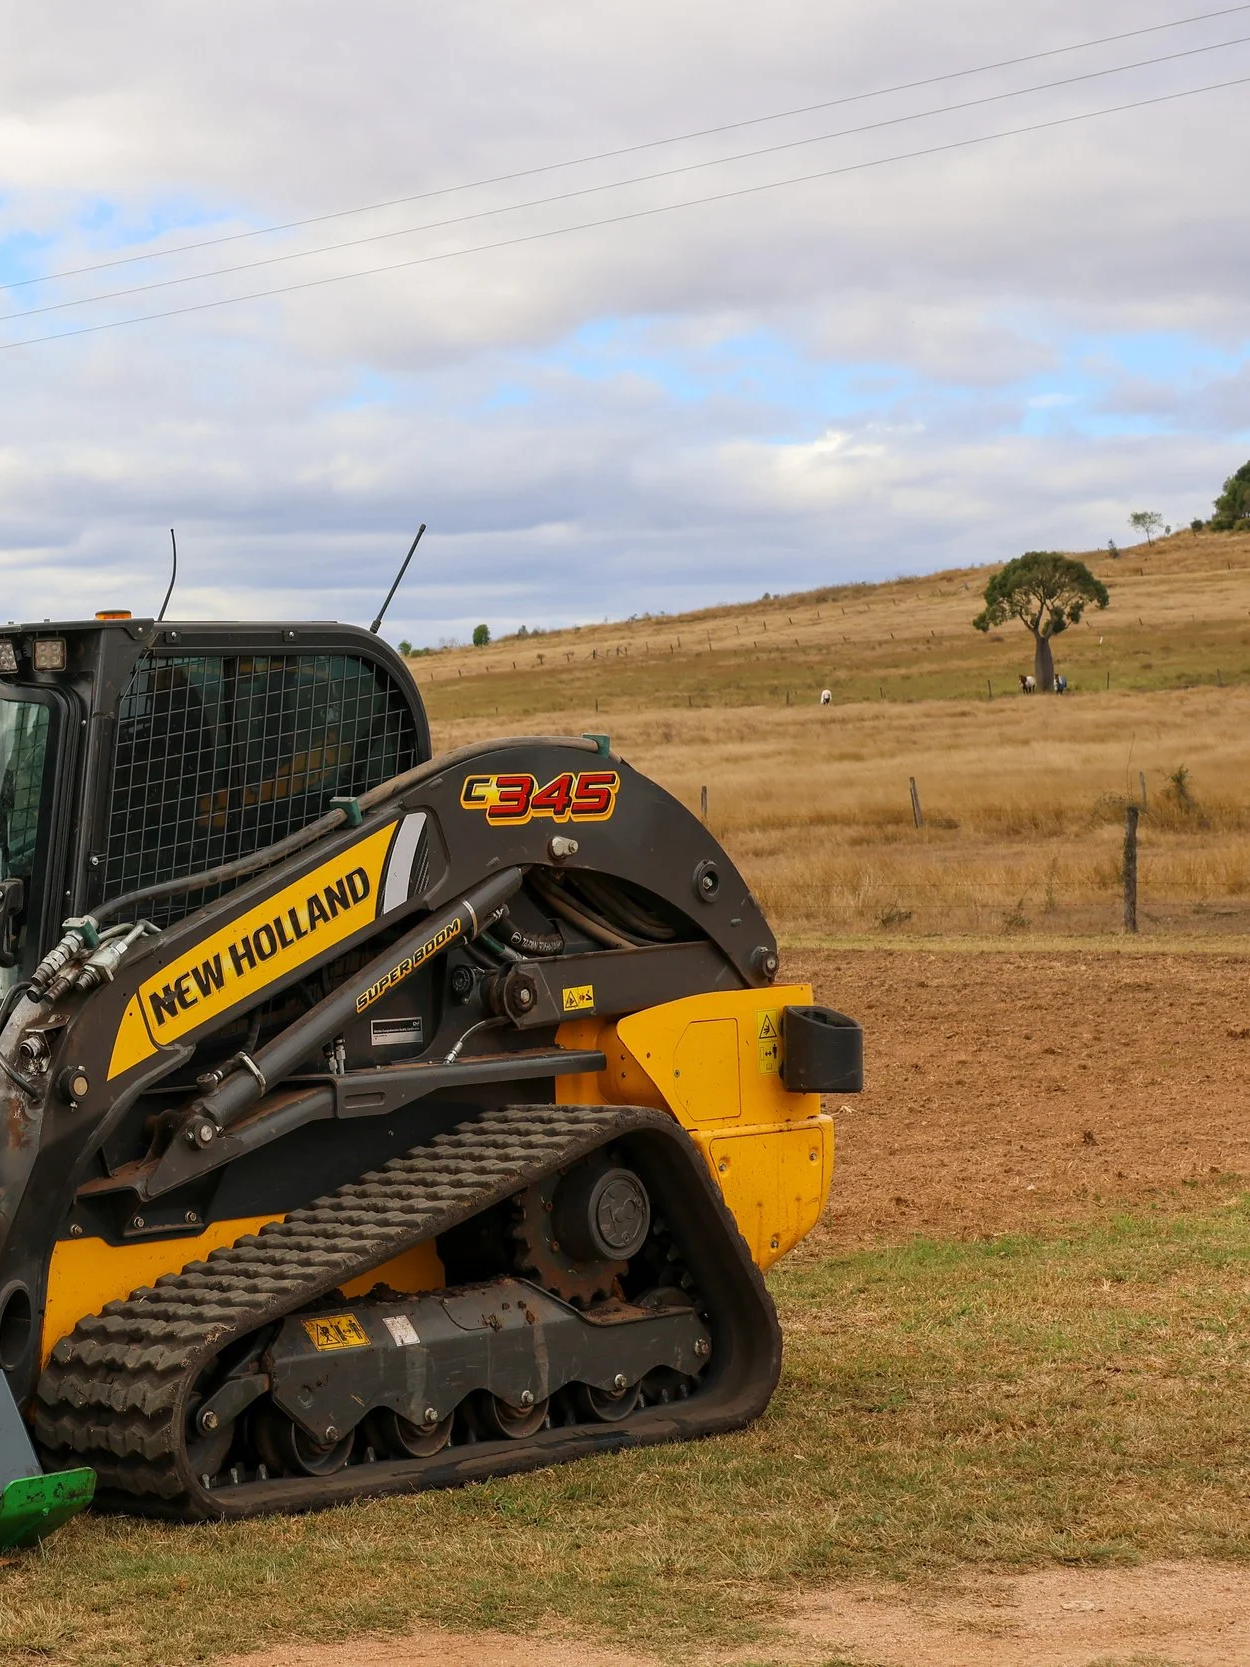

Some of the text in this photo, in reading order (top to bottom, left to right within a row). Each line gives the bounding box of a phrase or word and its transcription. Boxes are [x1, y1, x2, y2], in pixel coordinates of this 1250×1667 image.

[460, 770, 621, 826] C345
[148, 866, 370, 1027] NEW HOLLAND
[356, 917, 461, 1014] SUPER BOOM
